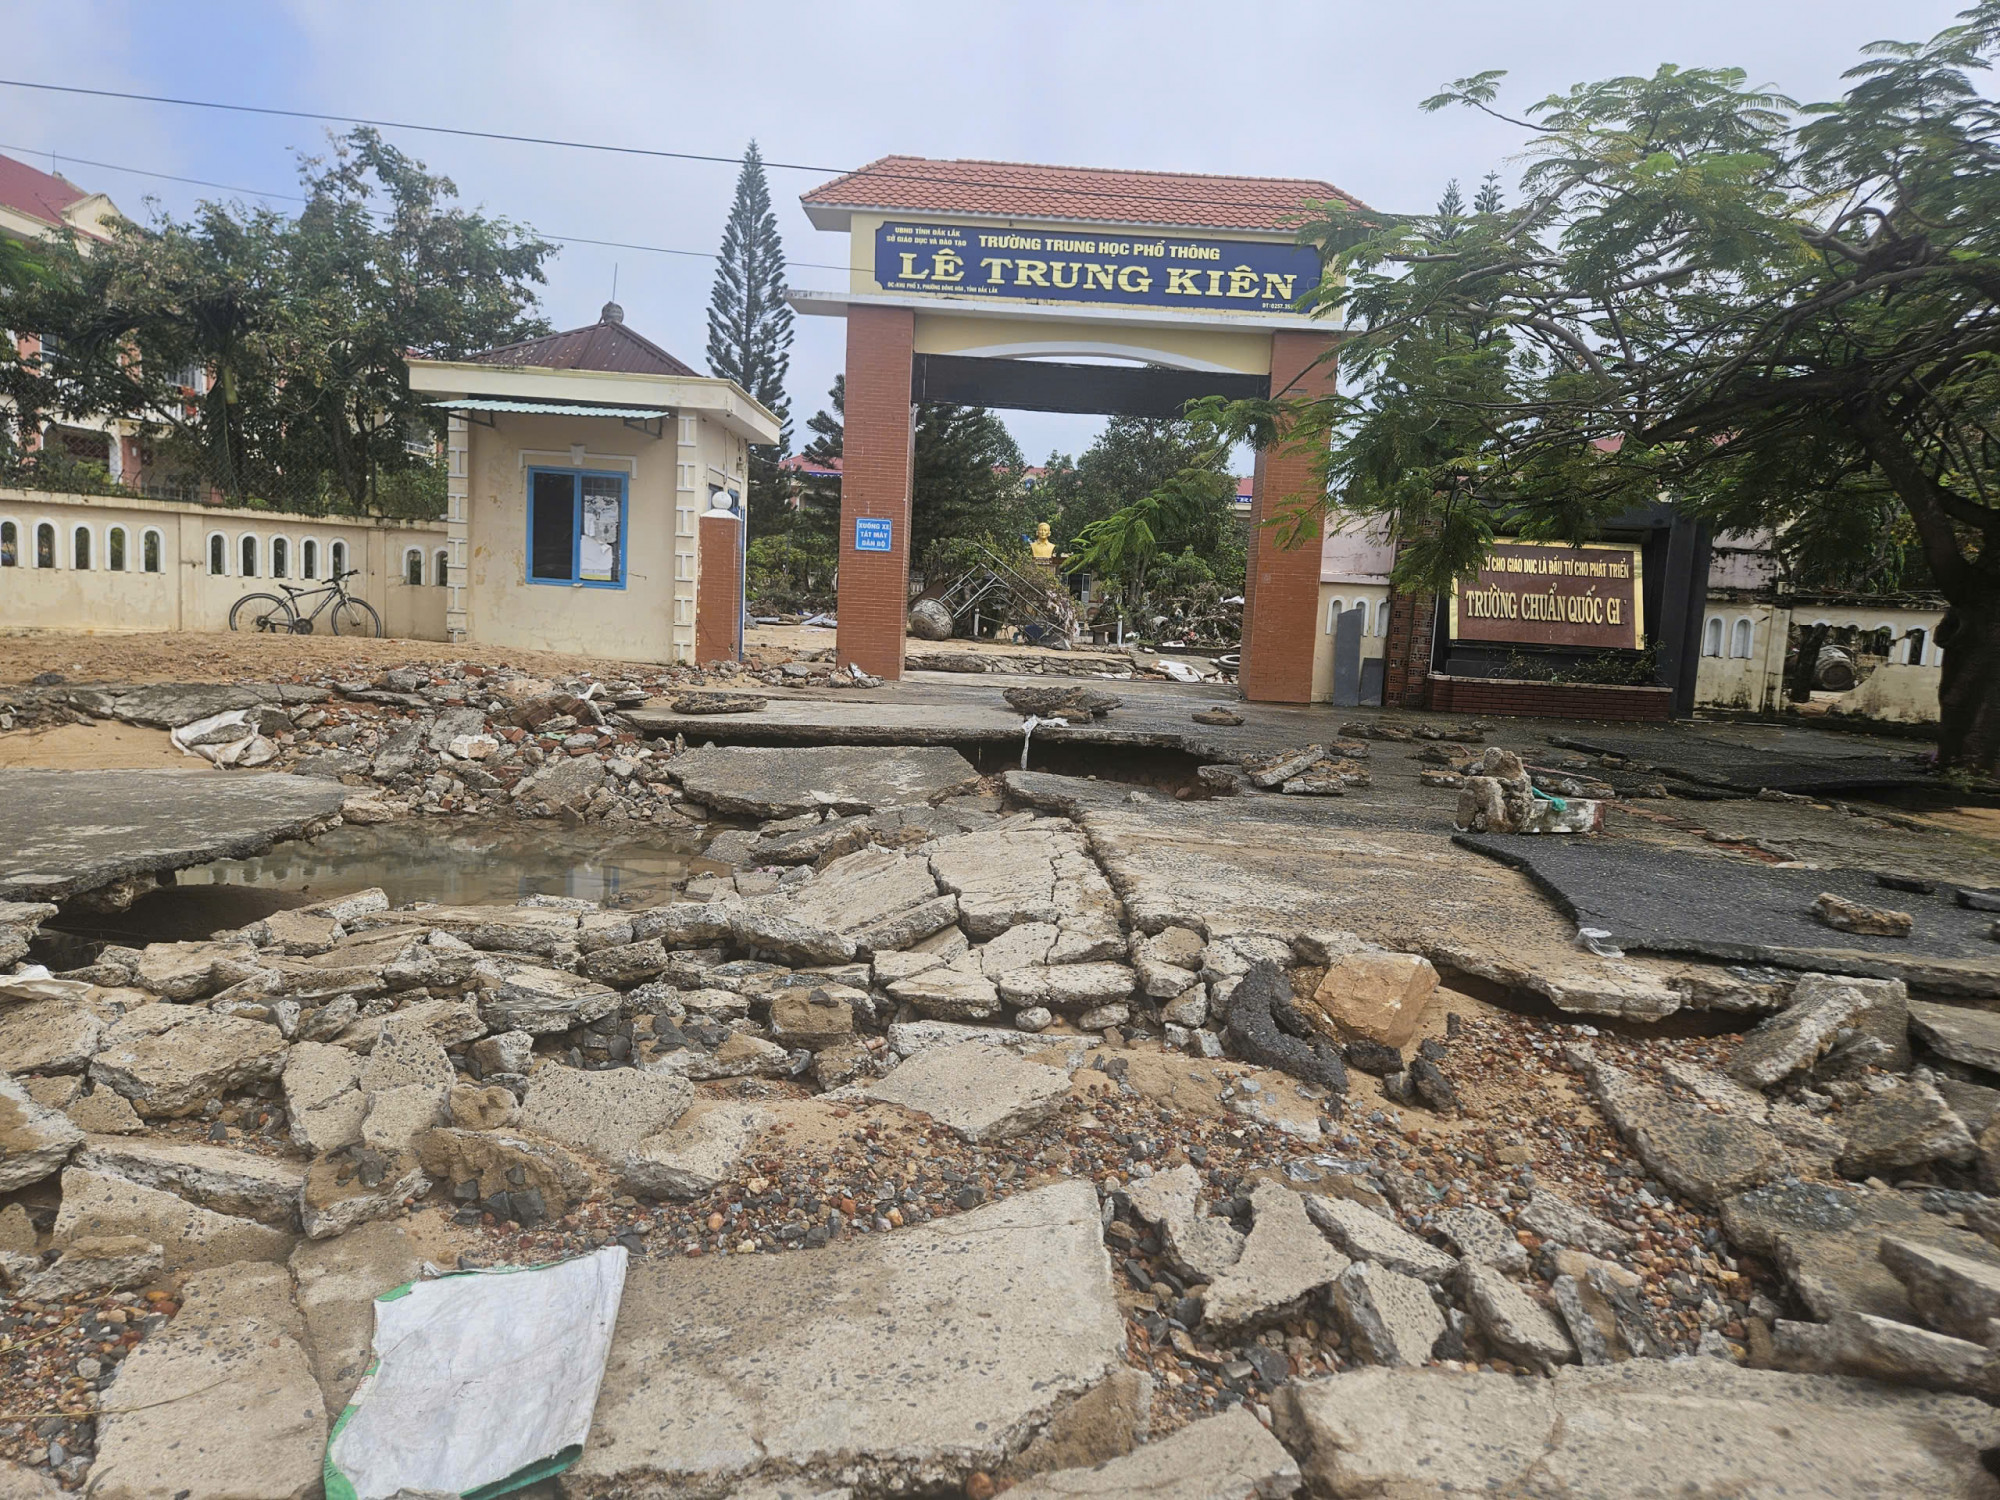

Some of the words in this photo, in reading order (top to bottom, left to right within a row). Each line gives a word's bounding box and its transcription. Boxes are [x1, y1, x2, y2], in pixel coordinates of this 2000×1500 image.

[896, 234, 912, 243] GIÁO
[978, 234, 1041, 250] TRƯỜNG
[1044, 238, 1096, 254] TRUNG
[1098, 241, 1130, 258] HỌC
[1133, 239, 1166, 258] PHỔ
[1168, 244, 1220, 260] THÔNG
[898, 248, 966, 282] LÊ
[979, 256, 1152, 294] TRUNG
[1164, 264, 1298, 300] KIÊN
[1491, 556, 1506, 572] CHO
[1507, 554, 1523, 573] GIÁO
[1538, 556, 1547, 574] LÀ
[1564, 558, 1574, 576] TƯ
[1574, 561, 1589, 576] CHO
[1589, 559, 1607, 578] PHÁT
[1608, 557, 1629, 579] TRIỂN
[1466, 582, 1518, 620] TRƯỜNG
[1521, 582, 1566, 622] CHUẨN
[1568, 584, 1603, 625] QUỐC
